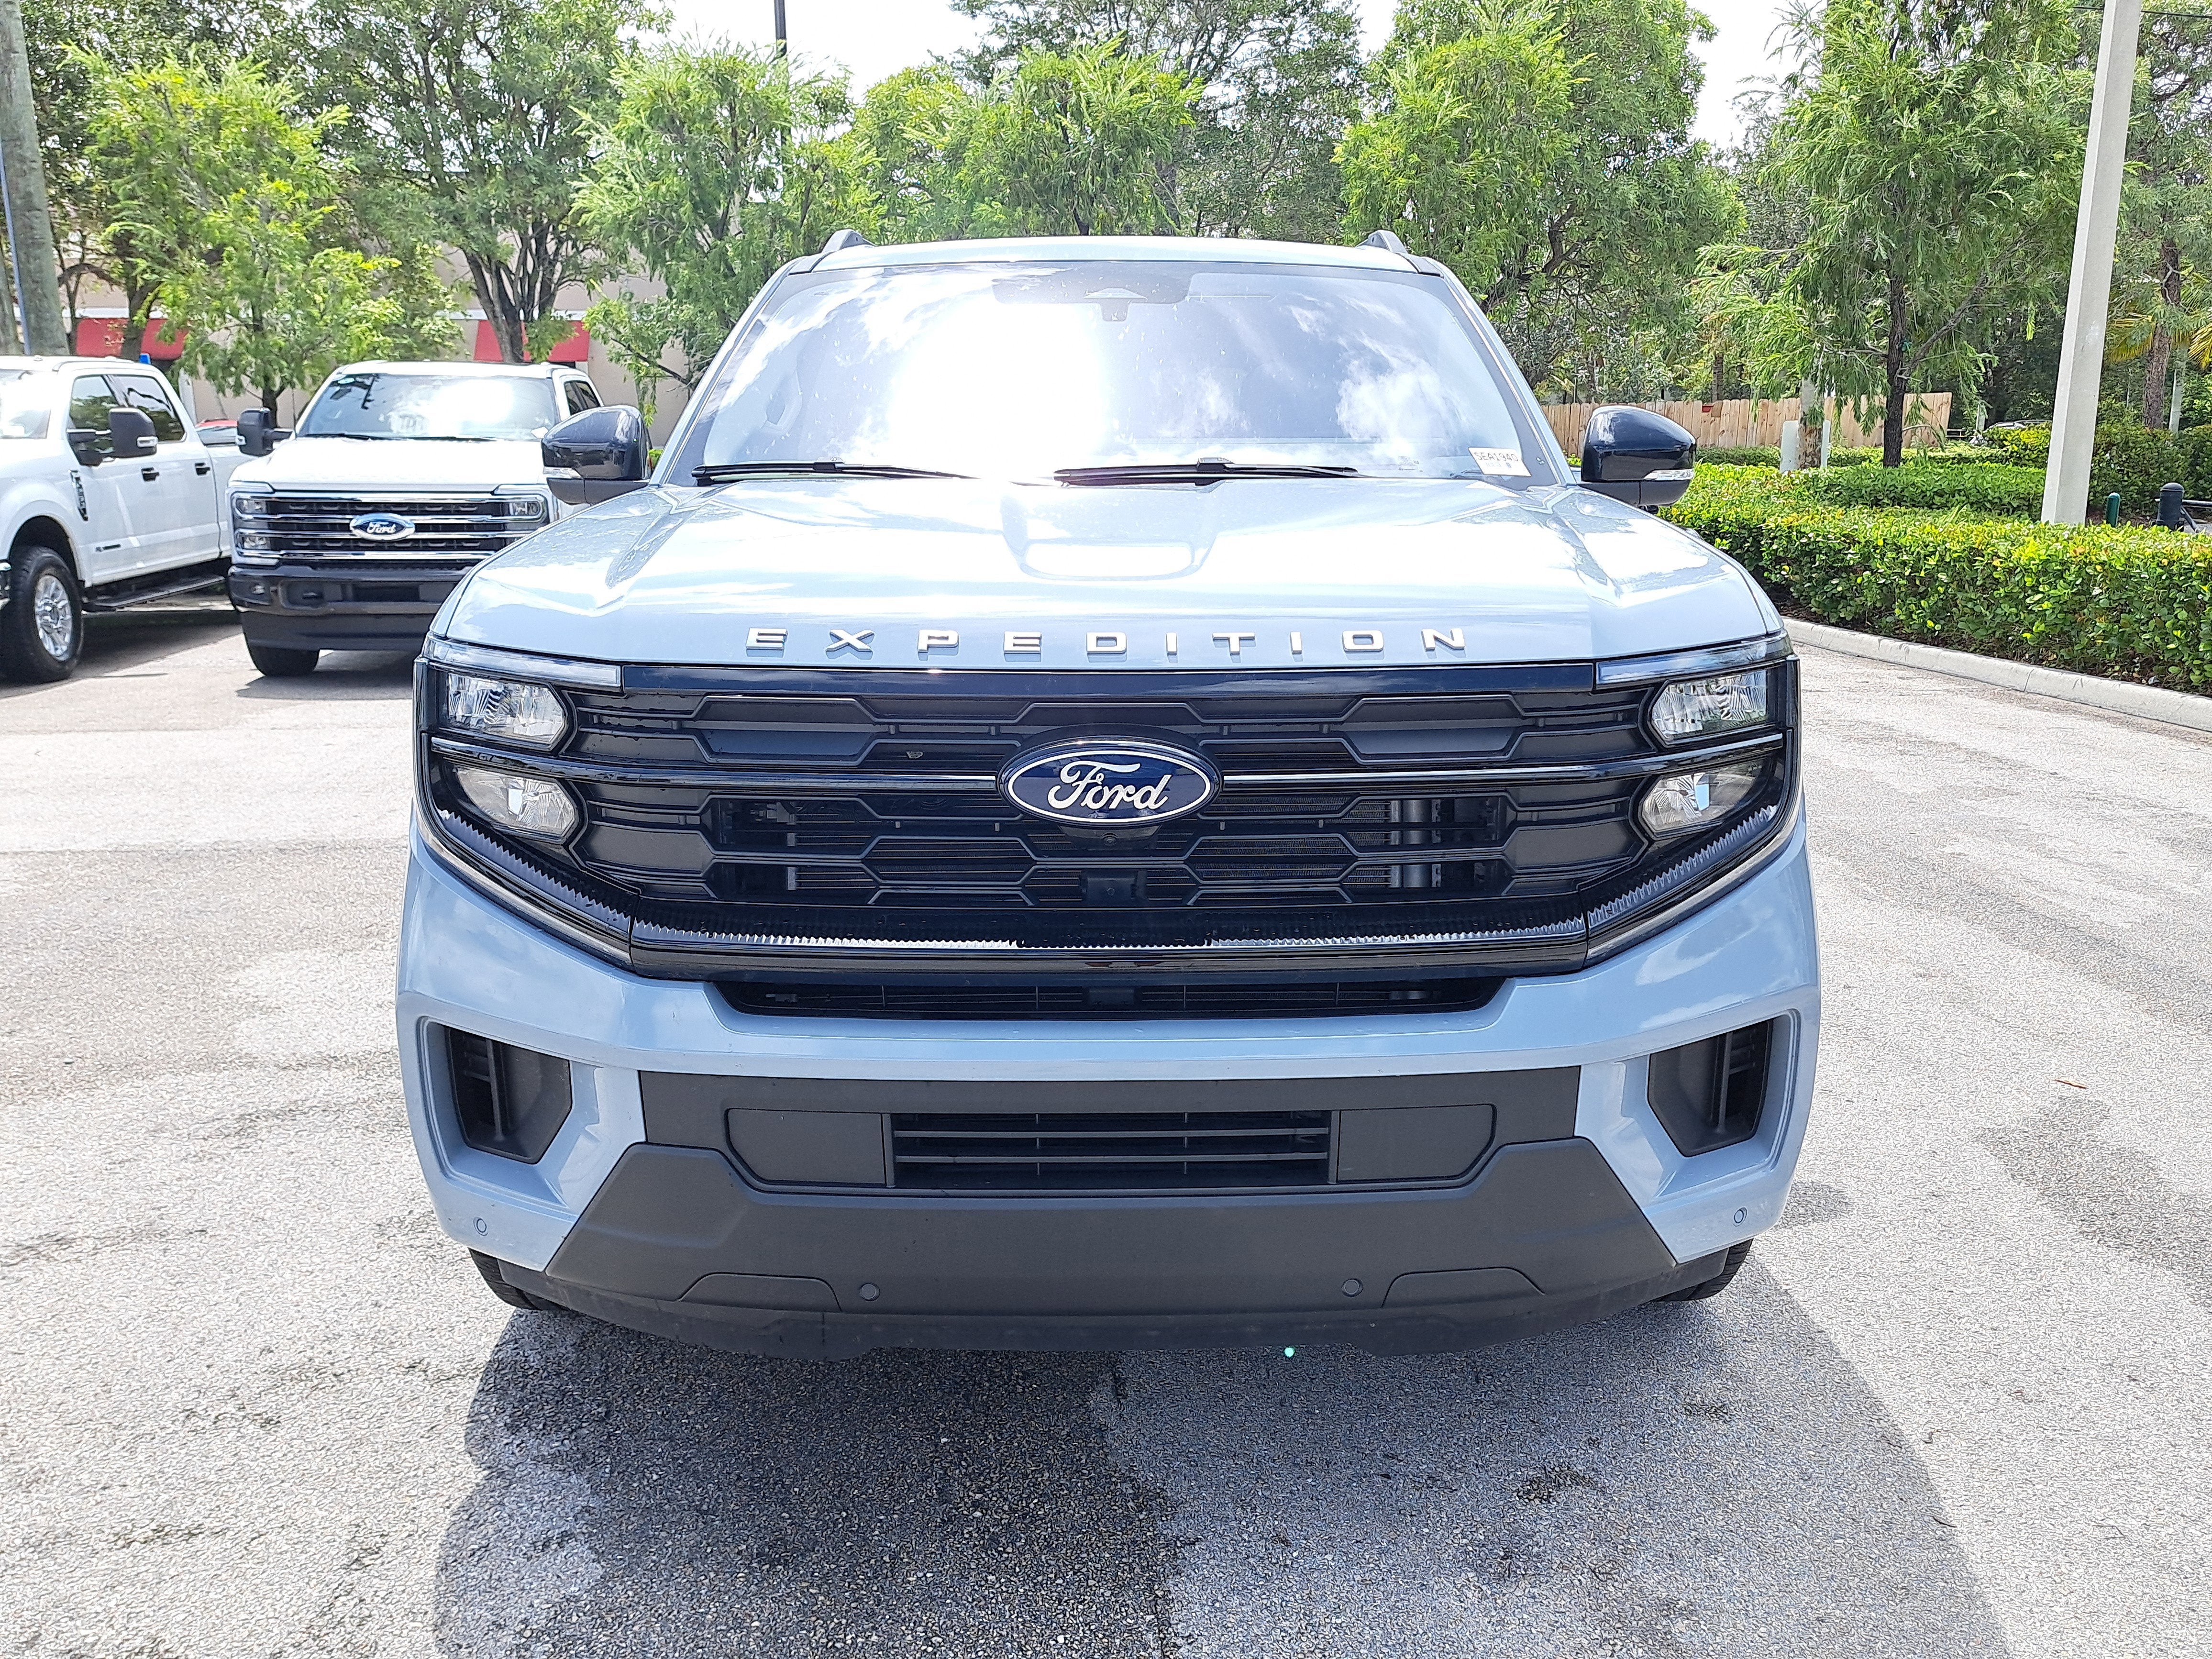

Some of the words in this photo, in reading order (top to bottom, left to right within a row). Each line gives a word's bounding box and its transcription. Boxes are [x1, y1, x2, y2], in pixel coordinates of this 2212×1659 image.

[1474, 452, 1518, 462] SEA1940
[366, 521, 397, 533] Ford
[745, 627, 1466, 654] EXPEDITION
[1047, 761, 1172, 810] Ford
